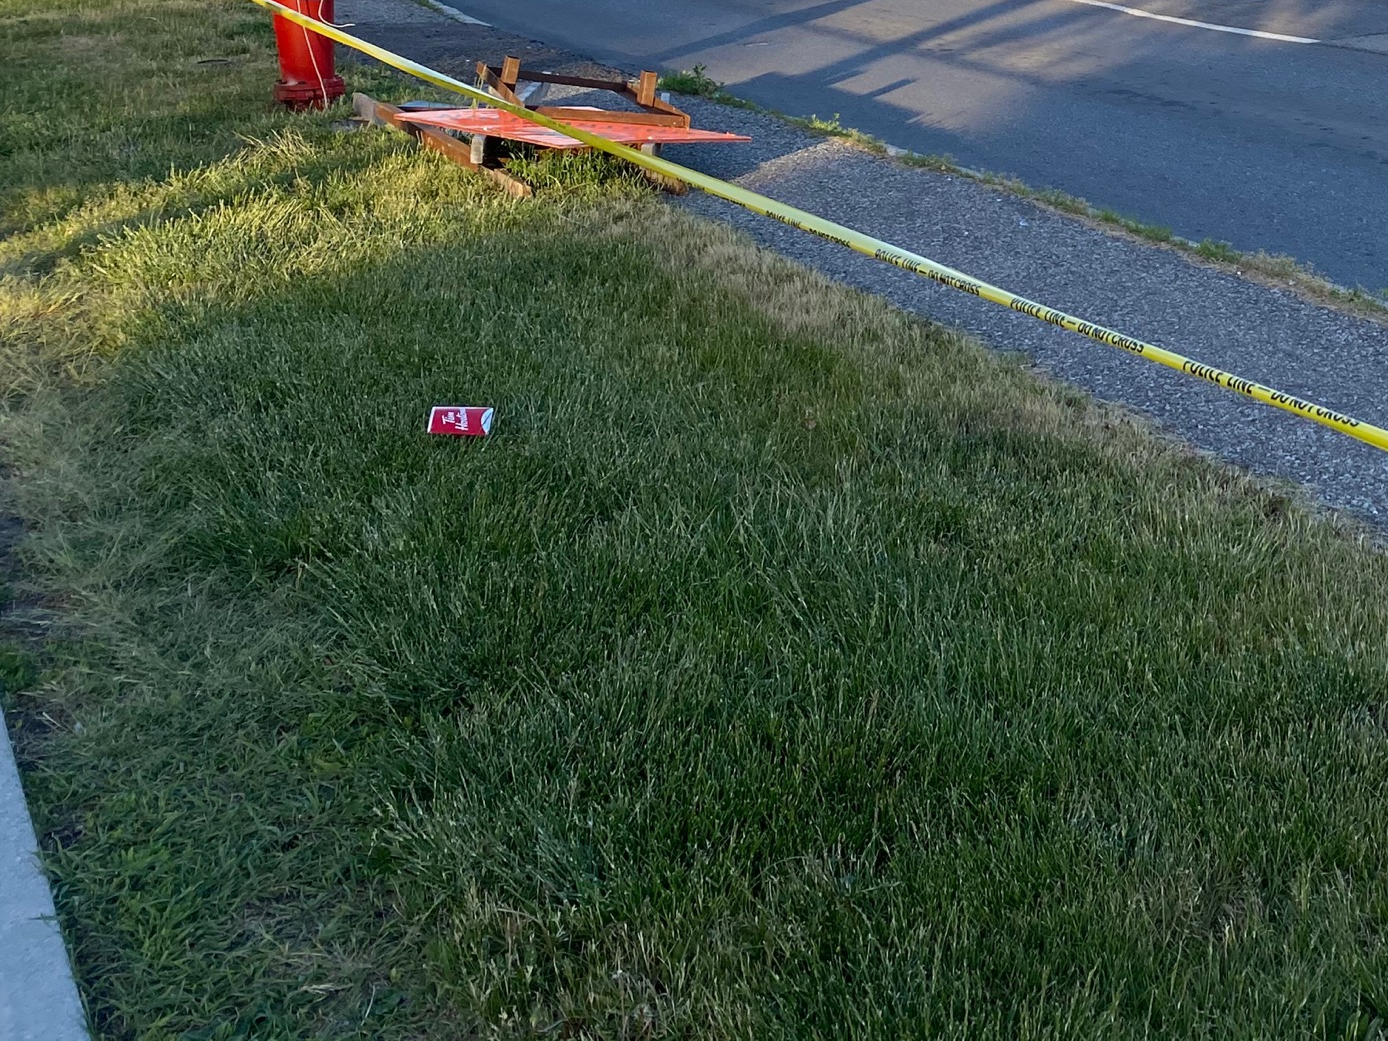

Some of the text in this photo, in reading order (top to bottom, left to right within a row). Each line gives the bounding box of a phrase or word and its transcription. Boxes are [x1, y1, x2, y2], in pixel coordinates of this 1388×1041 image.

[875, 248, 901, 267] POLICE
[902, 258, 921, 273] LINE
[955, 278, 981, 296] CROSS
[1010, 297, 1145, 354] POLICE LINE DO NOT CROSS
[1183, 360, 1223, 383] POLICE
[1226, 375, 1255, 395] LINE
